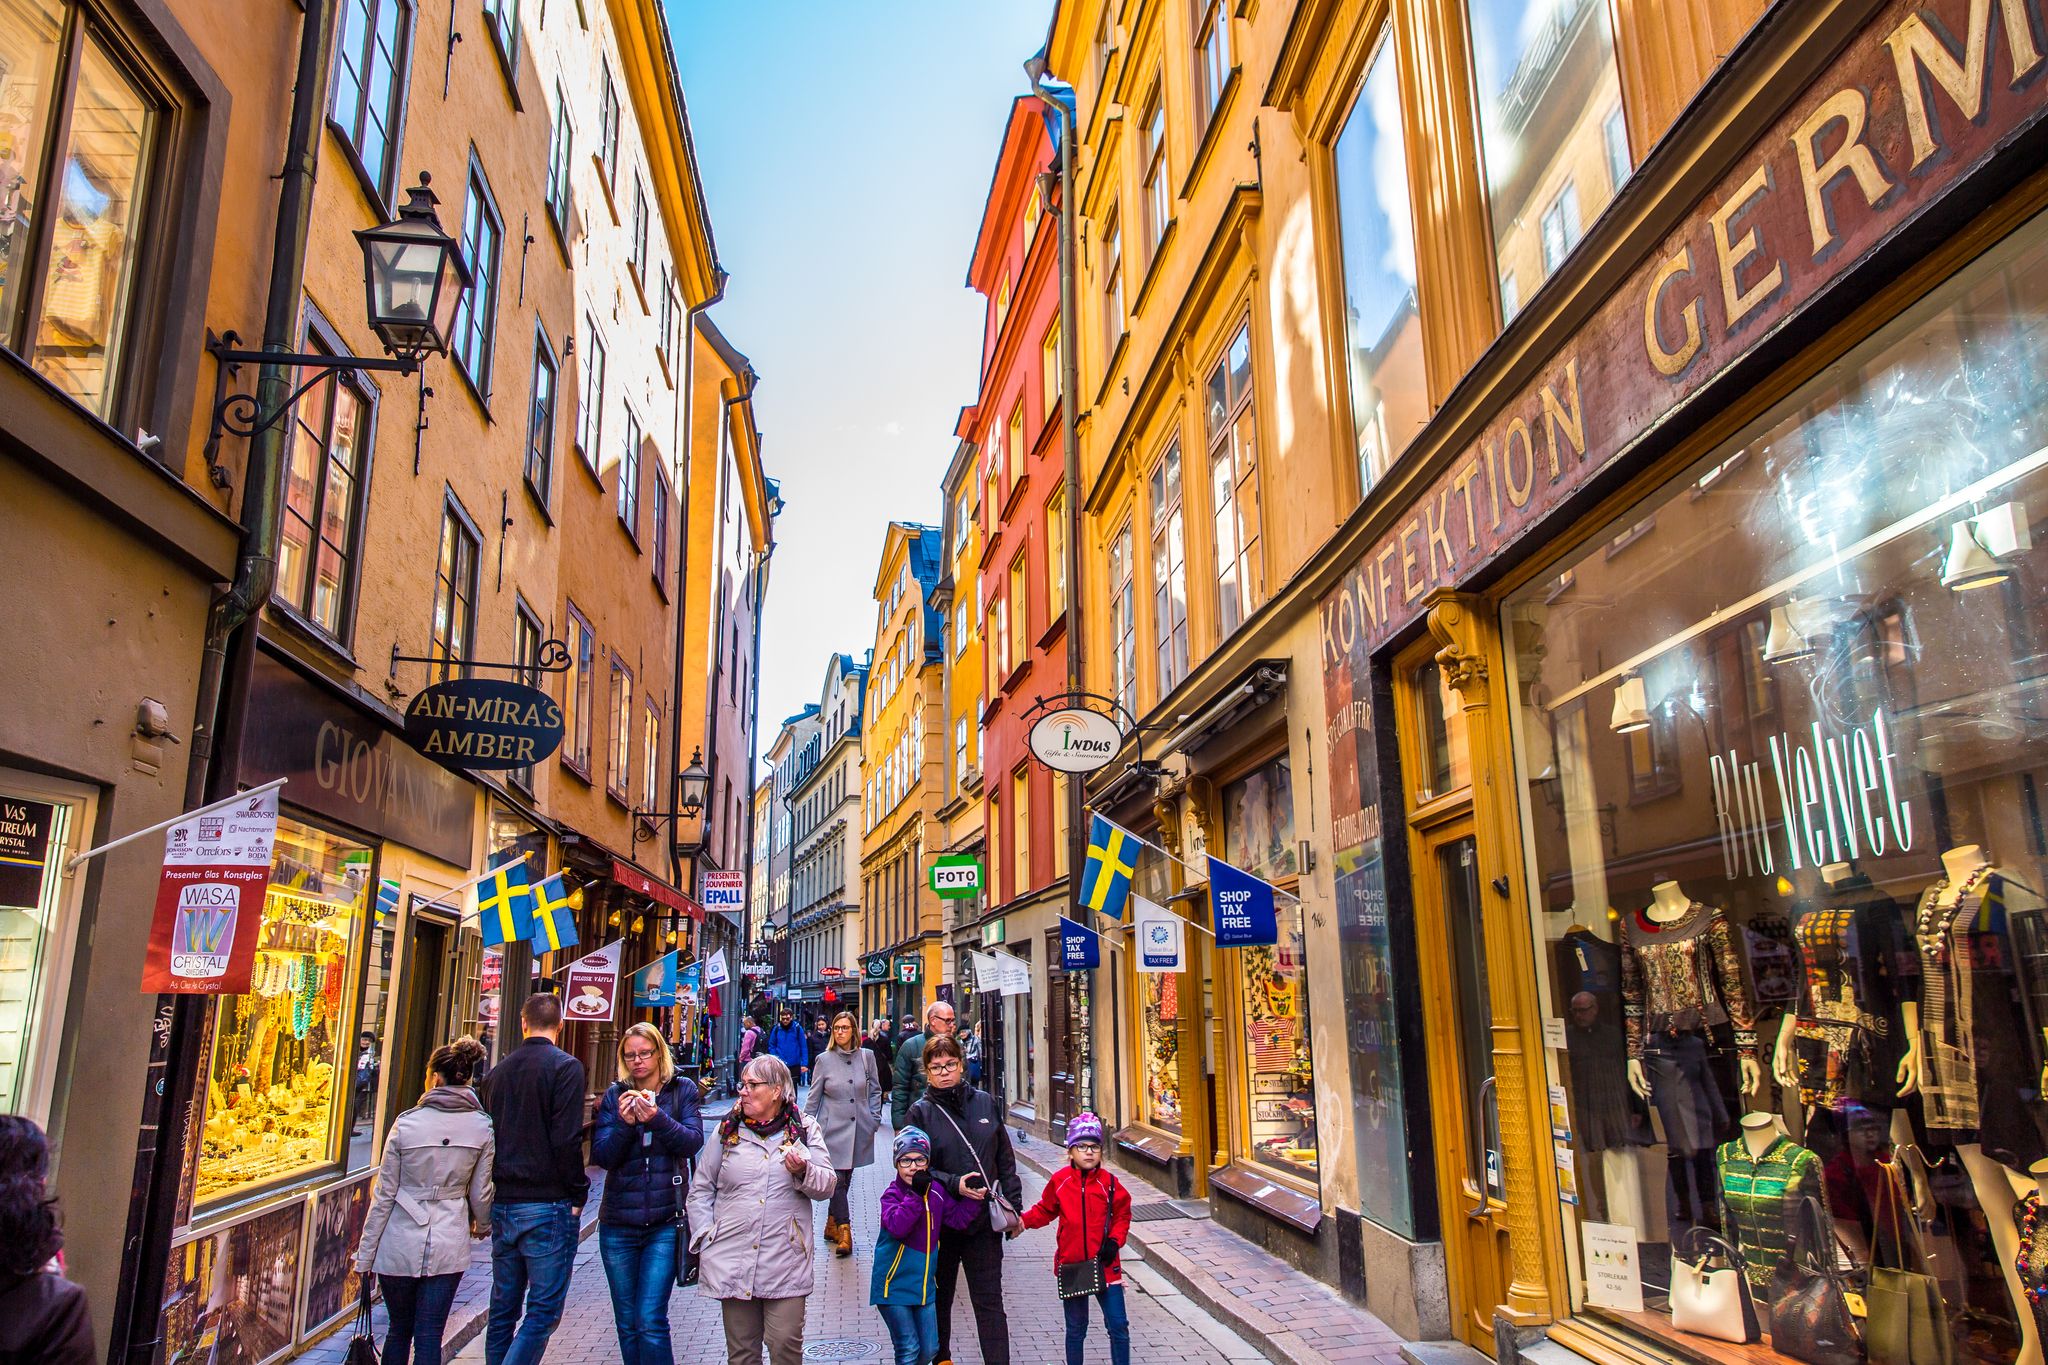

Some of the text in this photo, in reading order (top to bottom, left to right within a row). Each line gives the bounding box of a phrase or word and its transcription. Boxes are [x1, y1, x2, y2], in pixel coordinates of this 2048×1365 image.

[1319, 355, 1587, 673] KONFEKTION
[423, 728, 537, 762] AMBER
[315, 719, 442, 833] GIOVANNI
[1710, 706, 1912, 881] Blu Velvet
[236, 811, 275, 819] SWAROVSKI
[0, 821, 36, 838] TREUM
[0, 836, 26, 848] RYSTAL
[196, 845, 232, 857] Orrefors
[166, 870, 263, 880] Presenter Glas Konstglas
[708, 872, 740, 880] PRESENTER
[937, 870, 976, 883] FOTO
[706, 880, 742, 888] SOUVENIRER
[185, 888, 236, 906] WASA
[1219, 890, 1251, 903] SHOP
[1220, 904, 1244, 915] TAX
[1222, 917, 1252, 929] FREE
[1066, 936, 1086, 944] SHOP
[1066, 944, 1080, 952] TAX
[1067, 952, 1085, 960] FREE
[173, 955, 225, 970] CRYSTAL
[740, 962, 774, 975] Manhattan
[170, 981, 178, 989] As
